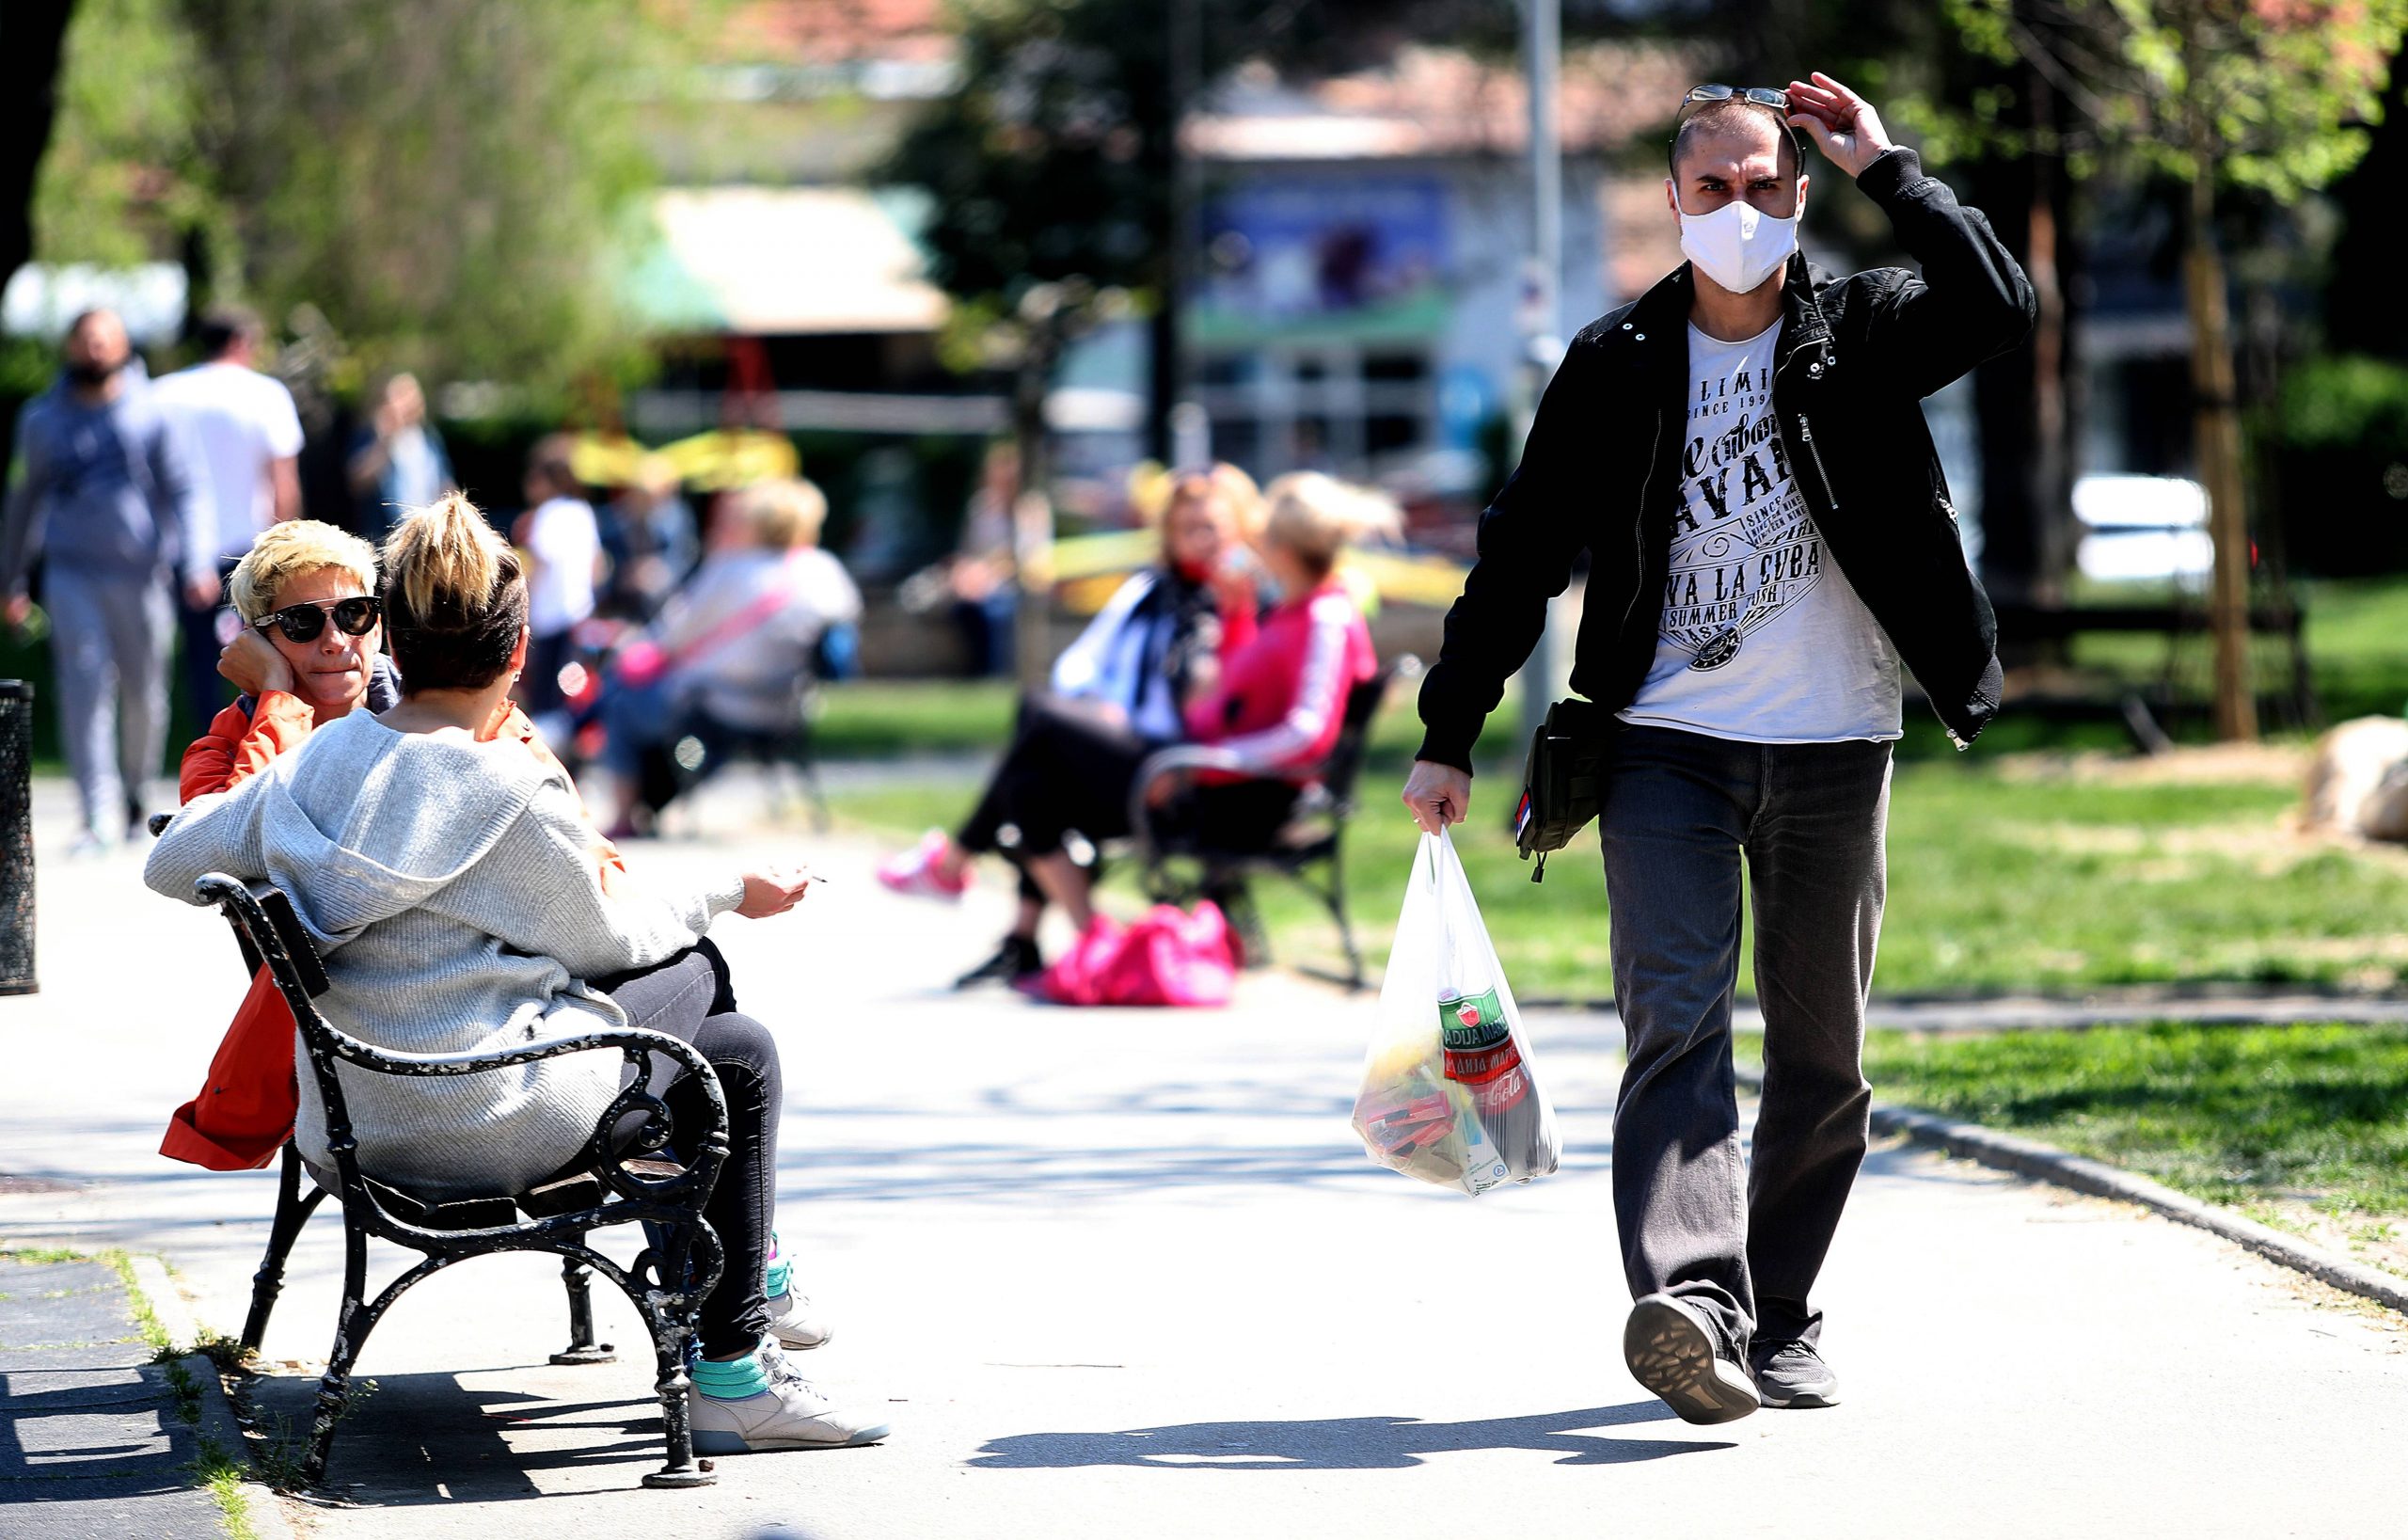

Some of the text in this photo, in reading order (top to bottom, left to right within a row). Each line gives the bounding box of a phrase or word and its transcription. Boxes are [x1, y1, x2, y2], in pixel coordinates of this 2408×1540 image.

[1739, 393, 1773, 408] 199
[1715, 564, 1746, 602] LA
[1760, 541, 1820, 586] CUBA
[1670, 602, 1737, 627] SUMMER
